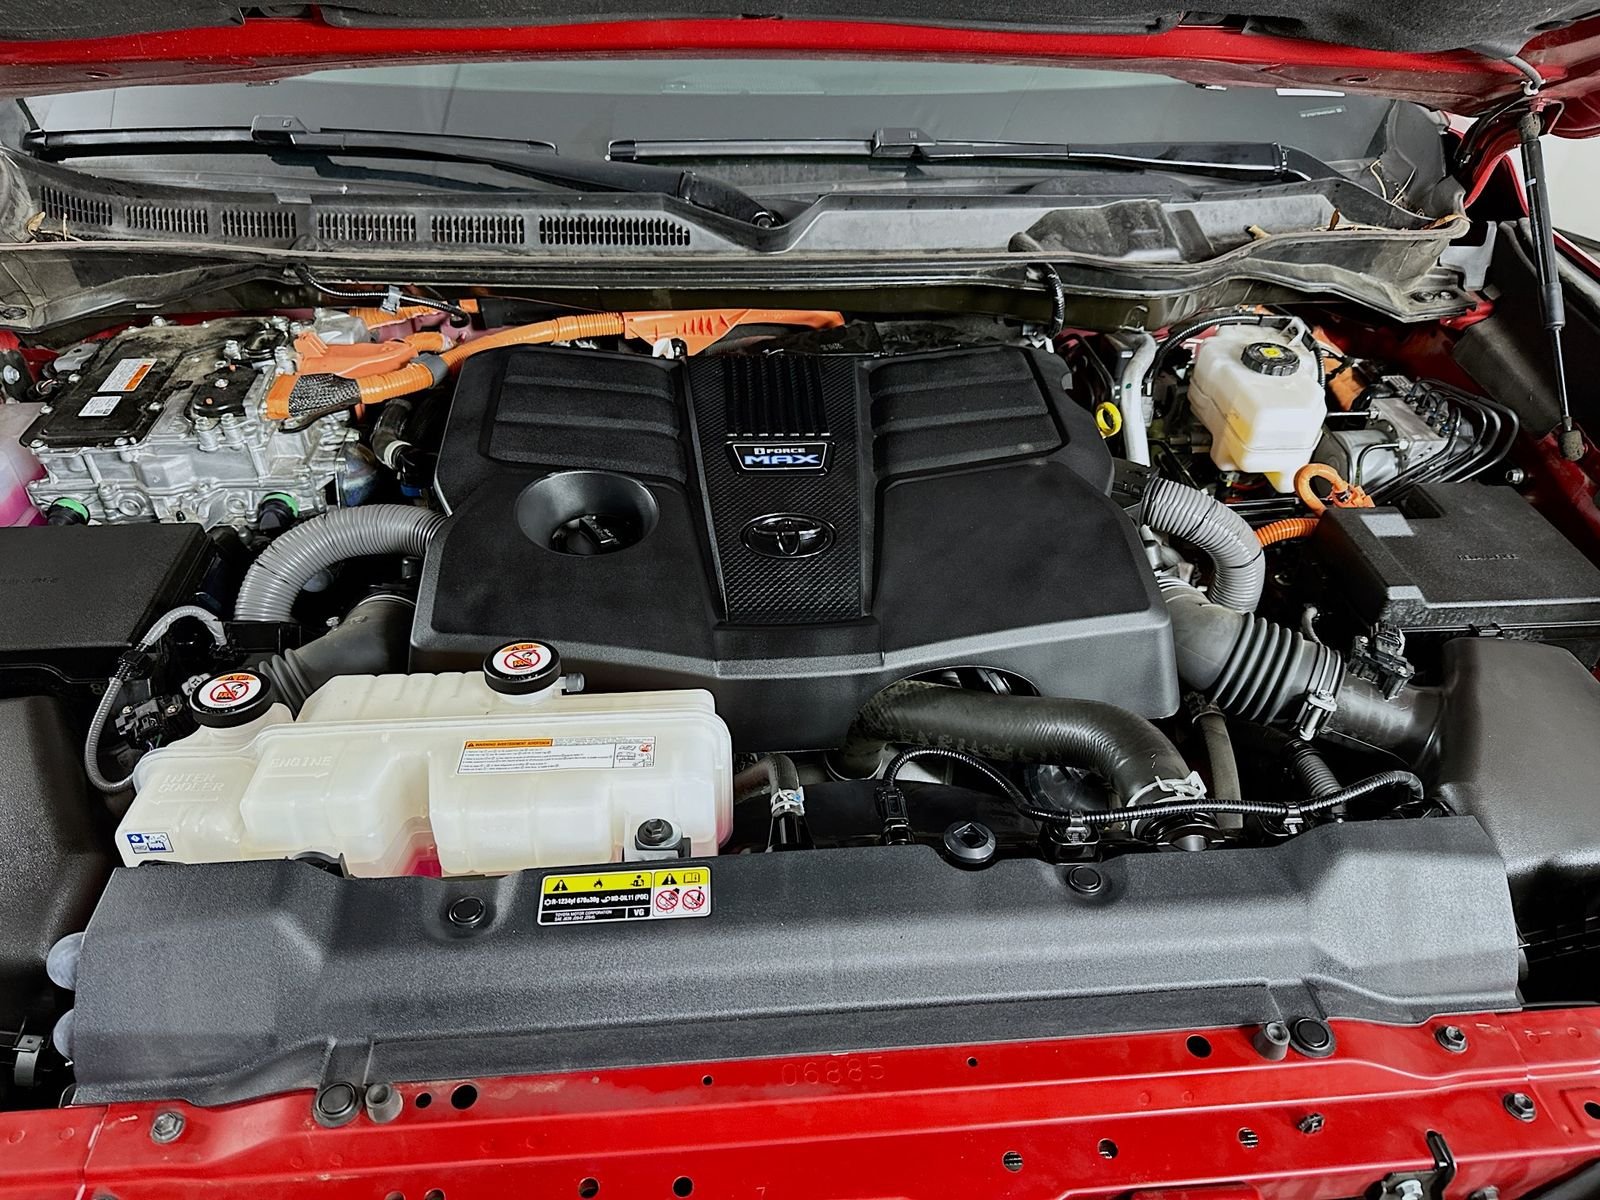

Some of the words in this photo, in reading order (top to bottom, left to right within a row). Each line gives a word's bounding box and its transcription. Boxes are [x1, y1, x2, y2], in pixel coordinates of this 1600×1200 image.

[744, 454, 820, 465] MAX
[270, 755, 334, 768] ENGINE
[163, 773, 215, 783] INTER
[158, 782, 225, 793] COOLER
[782, 1055, 886, 1087] 06885
